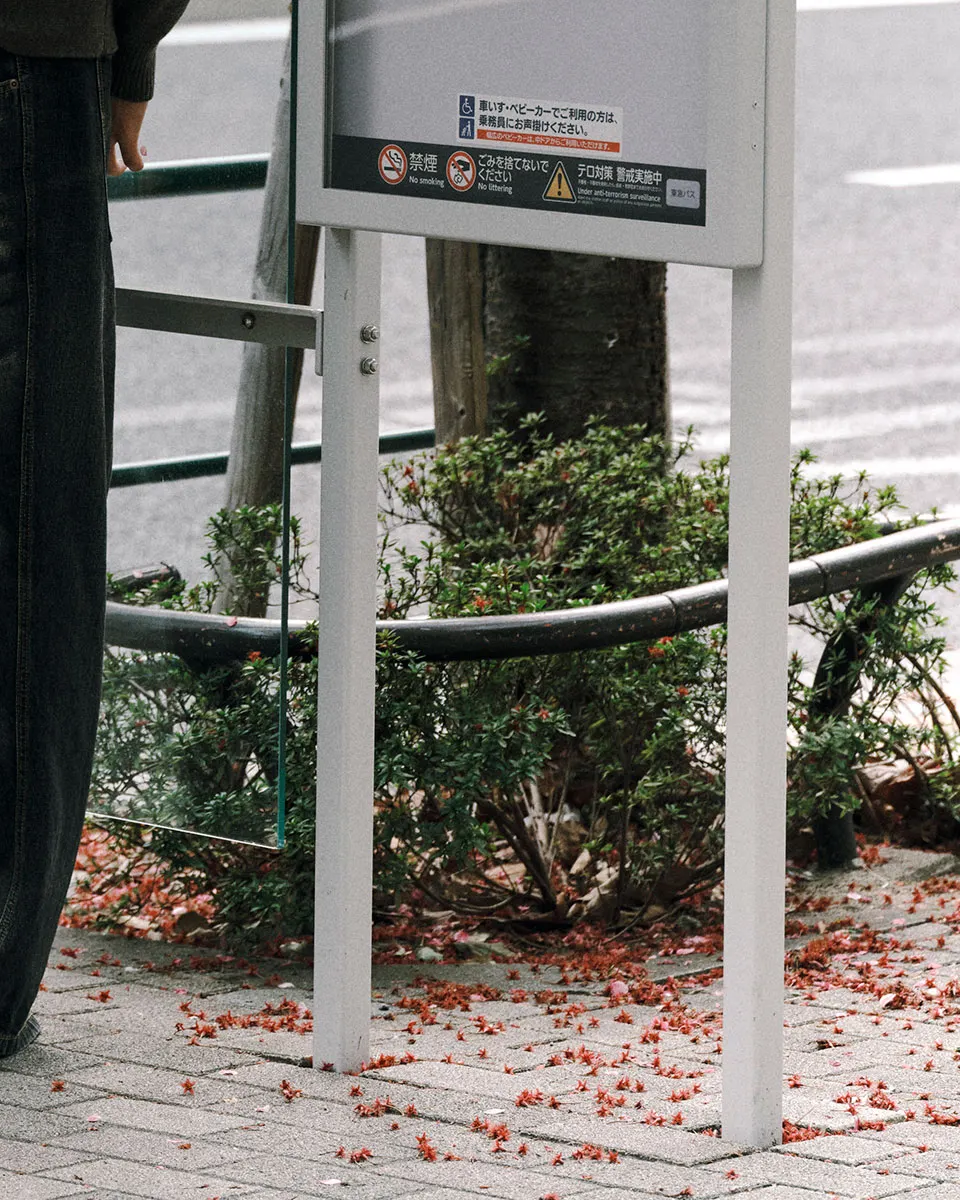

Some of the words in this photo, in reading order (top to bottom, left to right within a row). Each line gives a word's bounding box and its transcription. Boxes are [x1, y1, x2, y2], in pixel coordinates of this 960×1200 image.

[478, 100, 618, 124] 車いす・ベビーカーでご利用の方は、
[478, 114, 588, 137] 乗務員にお声掛けください。
[409, 152, 438, 173] 禁煙
[478, 154, 549, 173] ごみを捨てないで
[409, 175, 419, 184] No
[420, 176, 444, 188] smoking
[478, 168, 512, 183] ください
[577, 164, 614, 181] テロ対策
[616, 166, 663, 186] 警戒実施中
[478, 182, 487, 191] No
[488, 183, 513, 195] littering
[578, 187, 593, 196] Under
